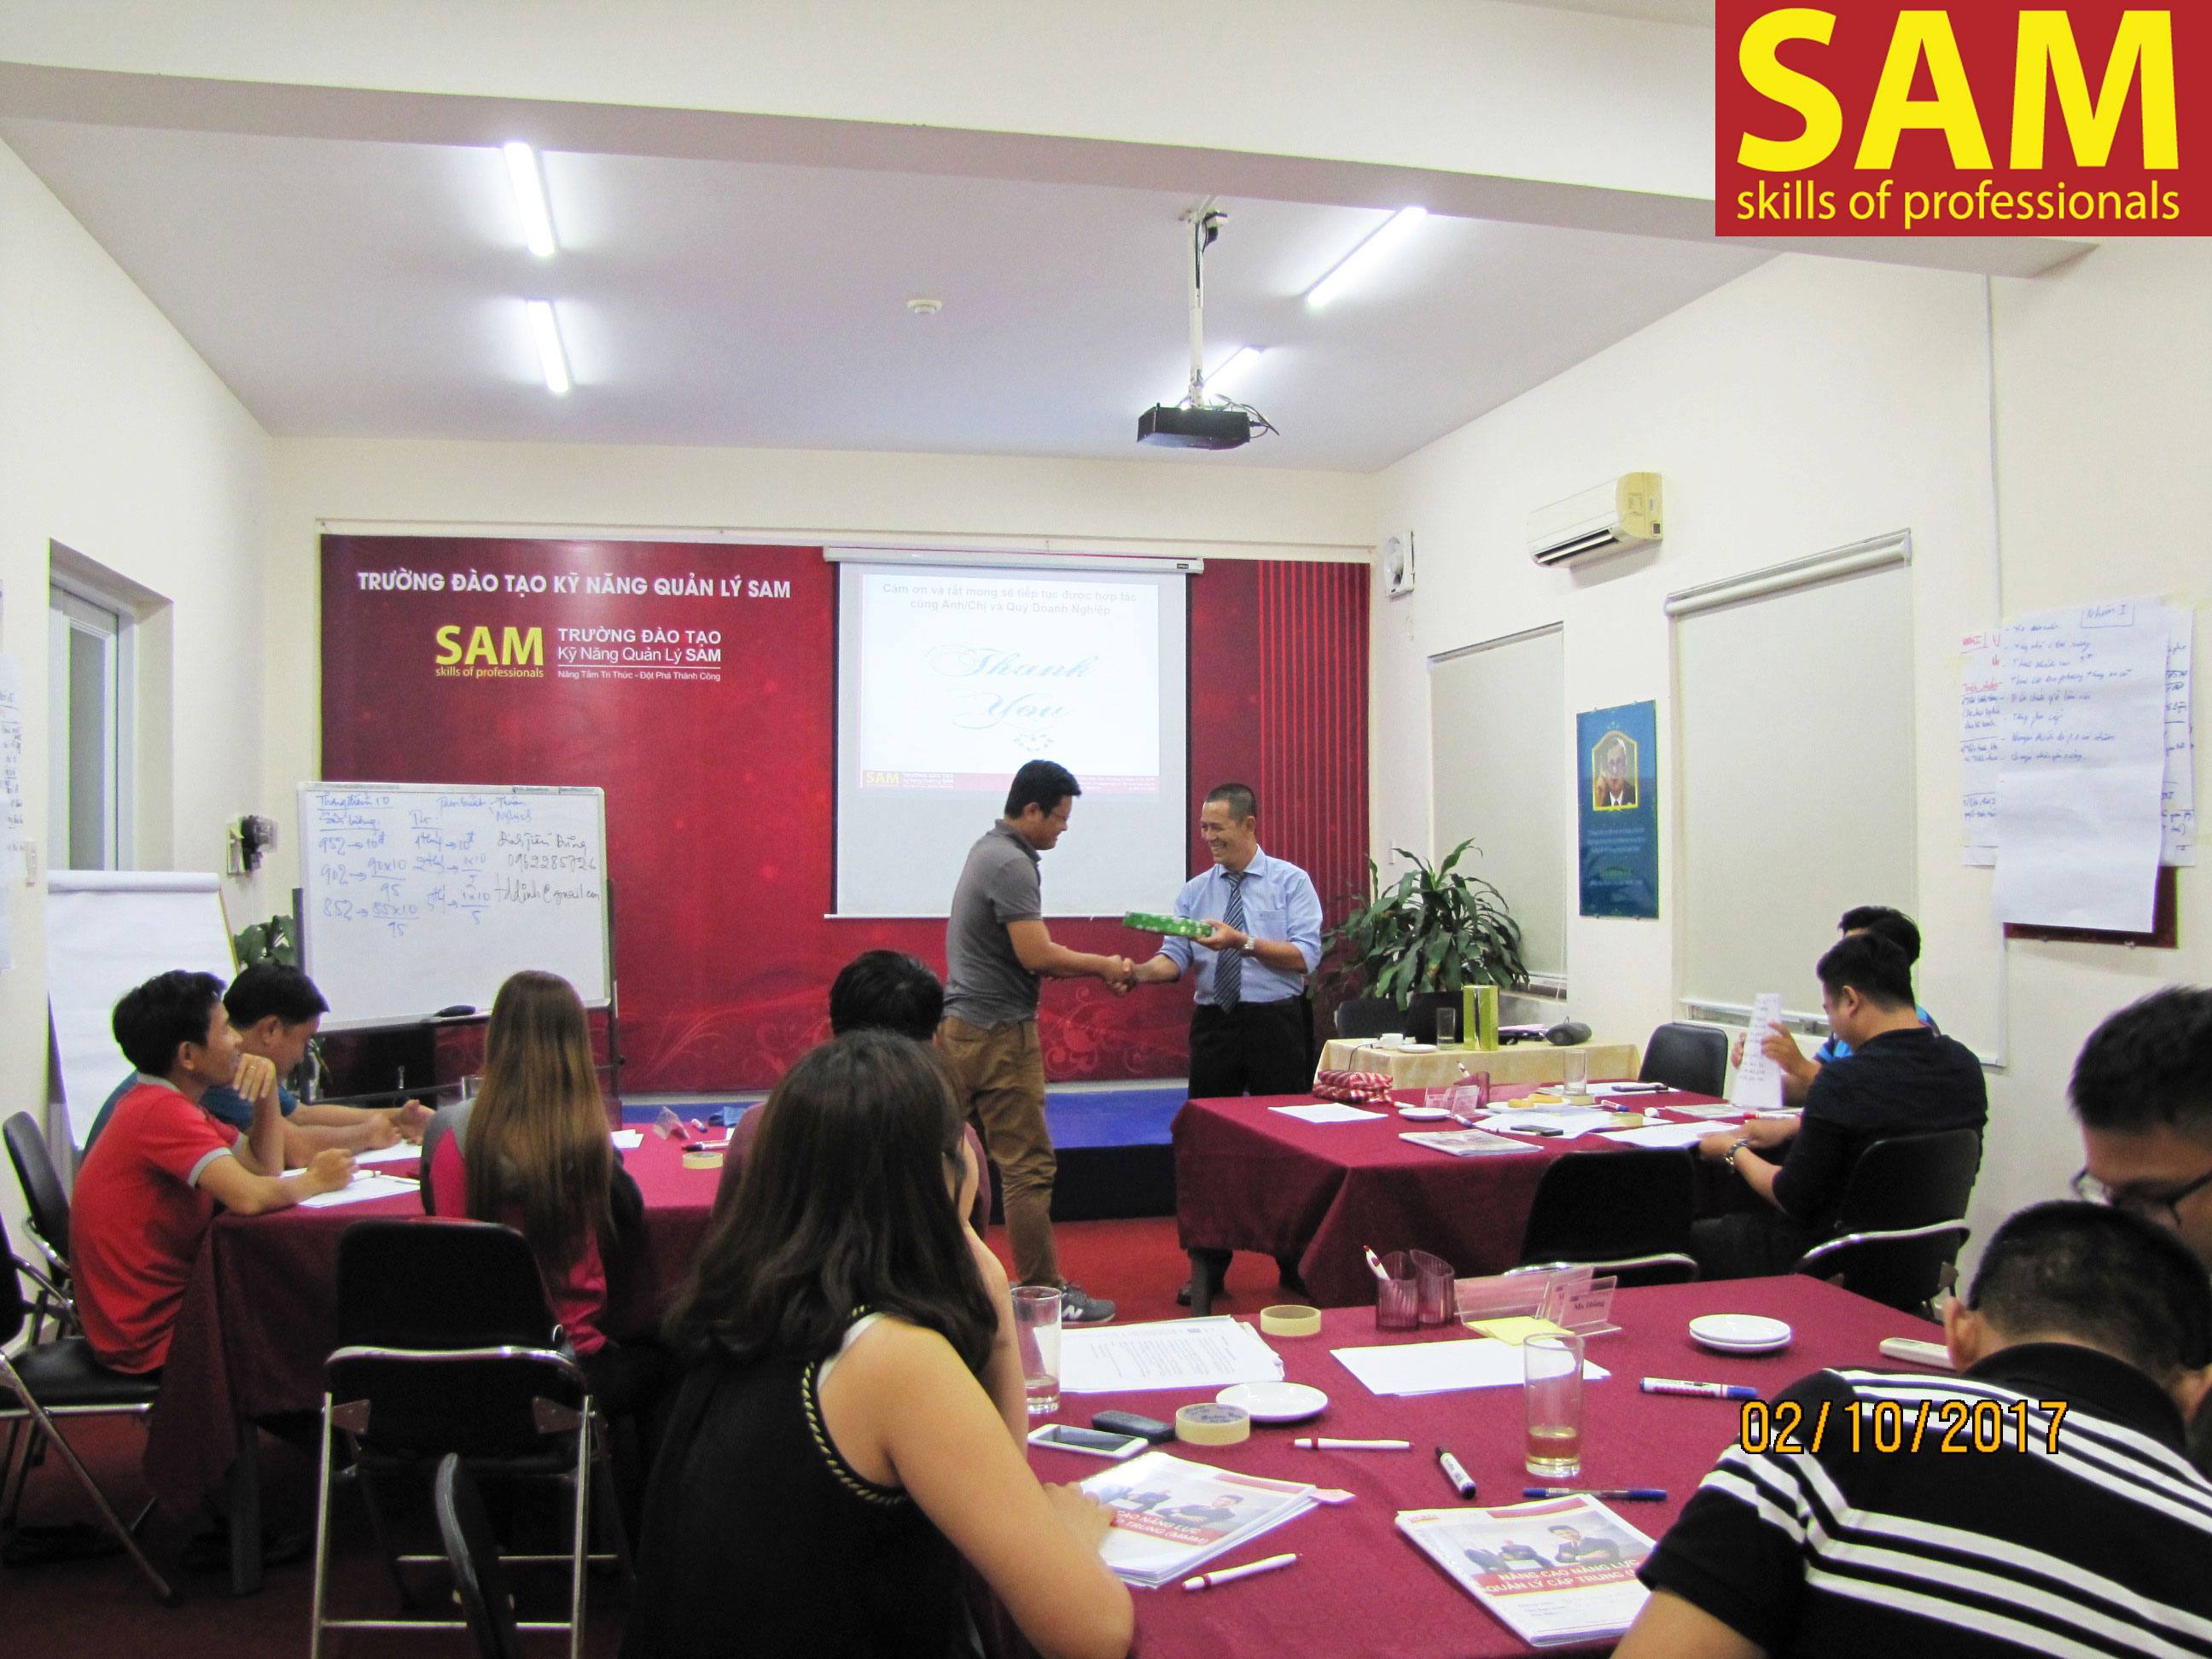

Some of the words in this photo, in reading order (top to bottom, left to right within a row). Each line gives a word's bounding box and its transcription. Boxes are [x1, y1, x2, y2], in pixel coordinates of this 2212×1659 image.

[358, 567, 445, 591] TRƯỜNG
[451, 568, 499, 592] ĐÀO
[504, 574, 547, 597] TẠO
[553, 571, 580, 594] KỸ
[586, 571, 649, 595] NĂNG
[654, 572, 714, 597] QUẢN
[720, 574, 742, 597] LÝ
[748, 580, 791, 599] SAM
[966, 587, 998, 599] mong
[1032, 602, 1068, 614] Doanh
[557, 626, 637, 643] TRƯỜNG
[641, 626, 680, 643] ĐÀO
[684, 630, 722, 647] TẠO
[435, 625, 544, 666] SAM
[557, 646, 578, 663] Kỹ
[580, 646, 620, 664] Năng
[622, 647, 661, 662] Quản
[665, 648, 683, 665] Lý
[685, 648, 722, 662] SAM
[925, 644, 1099, 678] Thank
[435, 667, 461, 677] skills
[463, 667, 474, 677] of
[476, 667, 544, 678] professionals
[946, 688, 1074, 731] You
[866, 771, 900, 784] SAM
[1540, 1569, 1570, 1579] CAO
[1575, 1569, 1625, 1584] TRUNG
